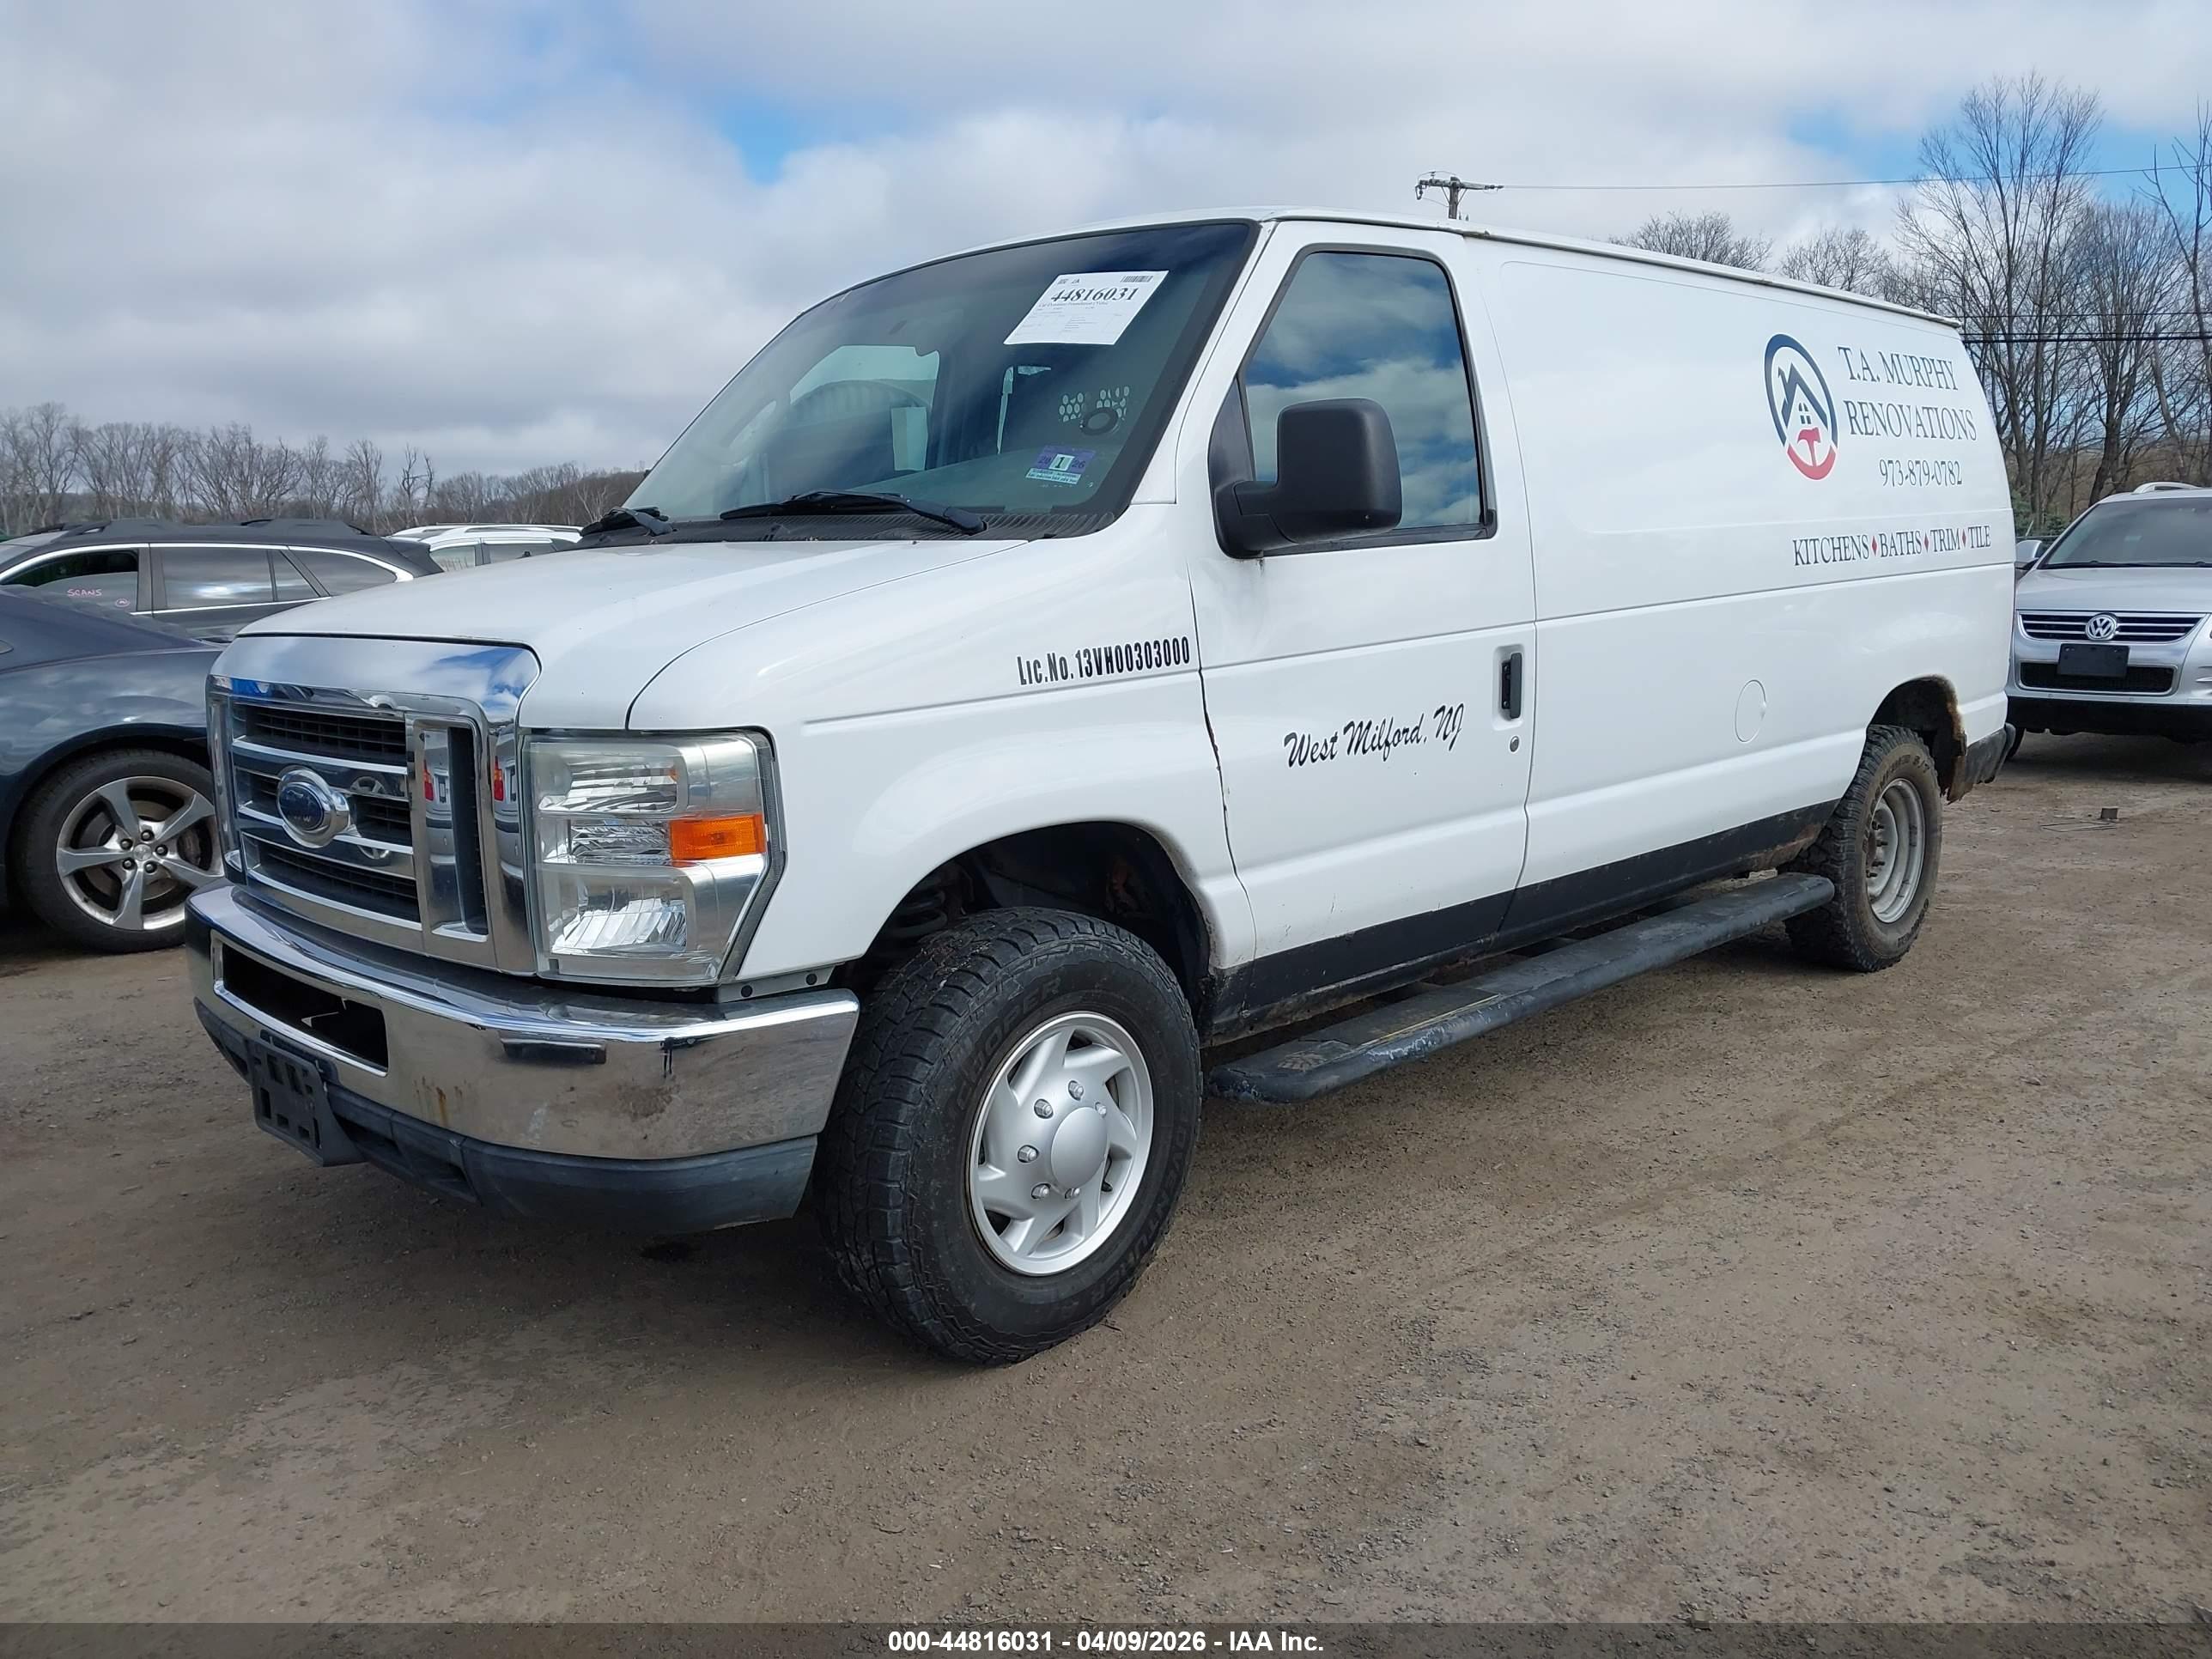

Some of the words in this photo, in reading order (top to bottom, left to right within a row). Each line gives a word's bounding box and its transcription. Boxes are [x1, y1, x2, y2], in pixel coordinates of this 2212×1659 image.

[1050, 286, 1139, 302] 44816031
[1838, 345, 1881, 384] T.A.
[1878, 351, 1959, 391] MURPHY
[1843, 399, 1978, 441] RENOVATIONS
[1879, 459, 1964, 488] 973-879-0782
[1792, 533, 1870, 567] KITCHENS
[1879, 529, 1923, 558] BATHS
[1929, 527, 1962, 553] TRIM
[1967, 525, 1992, 549] TILE
[67, 588, 103, 597] SCANS
[1284, 732, 1338, 768] West
[1342, 712, 1427, 762] Milford,
[1433, 702, 1464, 751] NJ
